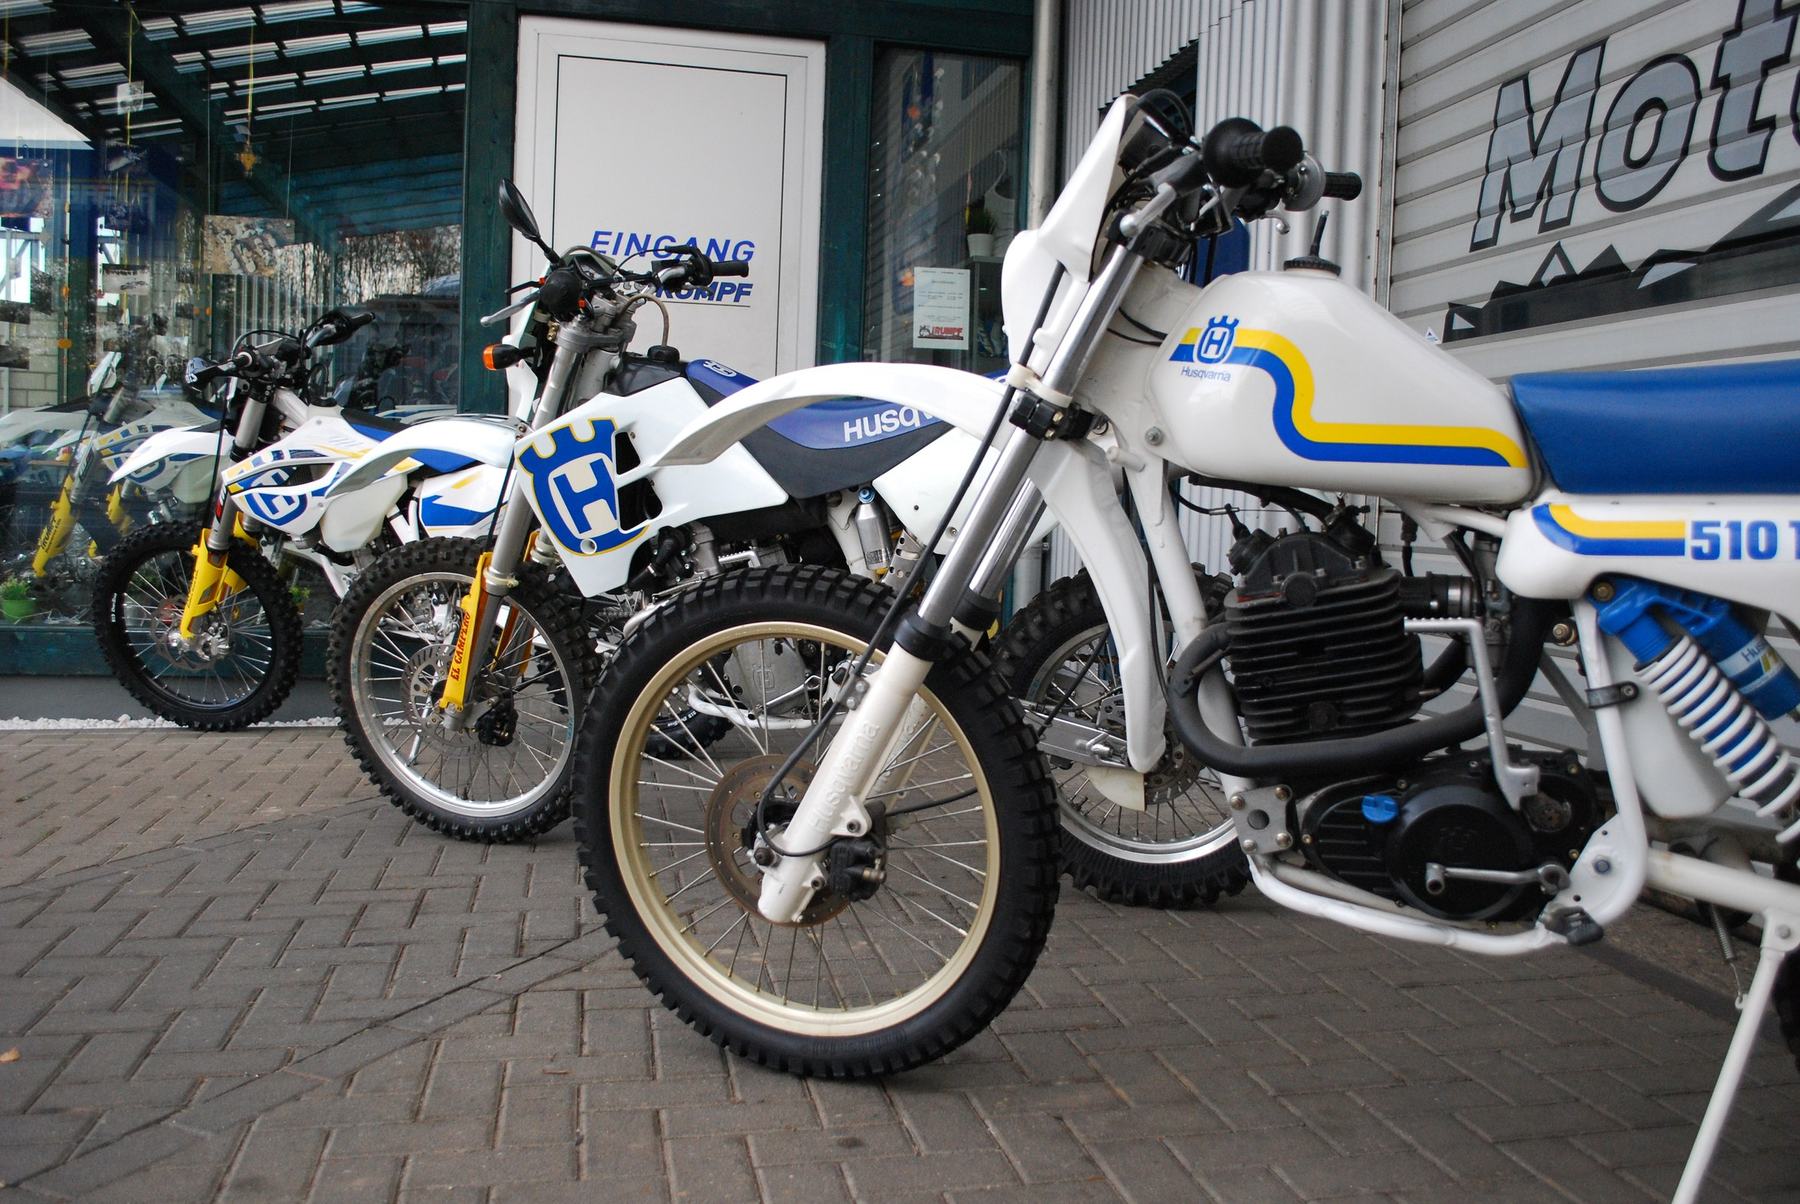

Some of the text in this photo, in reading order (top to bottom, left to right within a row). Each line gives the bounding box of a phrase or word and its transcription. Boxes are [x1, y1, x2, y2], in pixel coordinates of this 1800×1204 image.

[590, 230, 755, 264] EINGANG
[1181, 367, 1231, 381] Husqvarna
[1690, 520, 1778, 560] 510
[807, 721, 881, 834] Husqvarna
